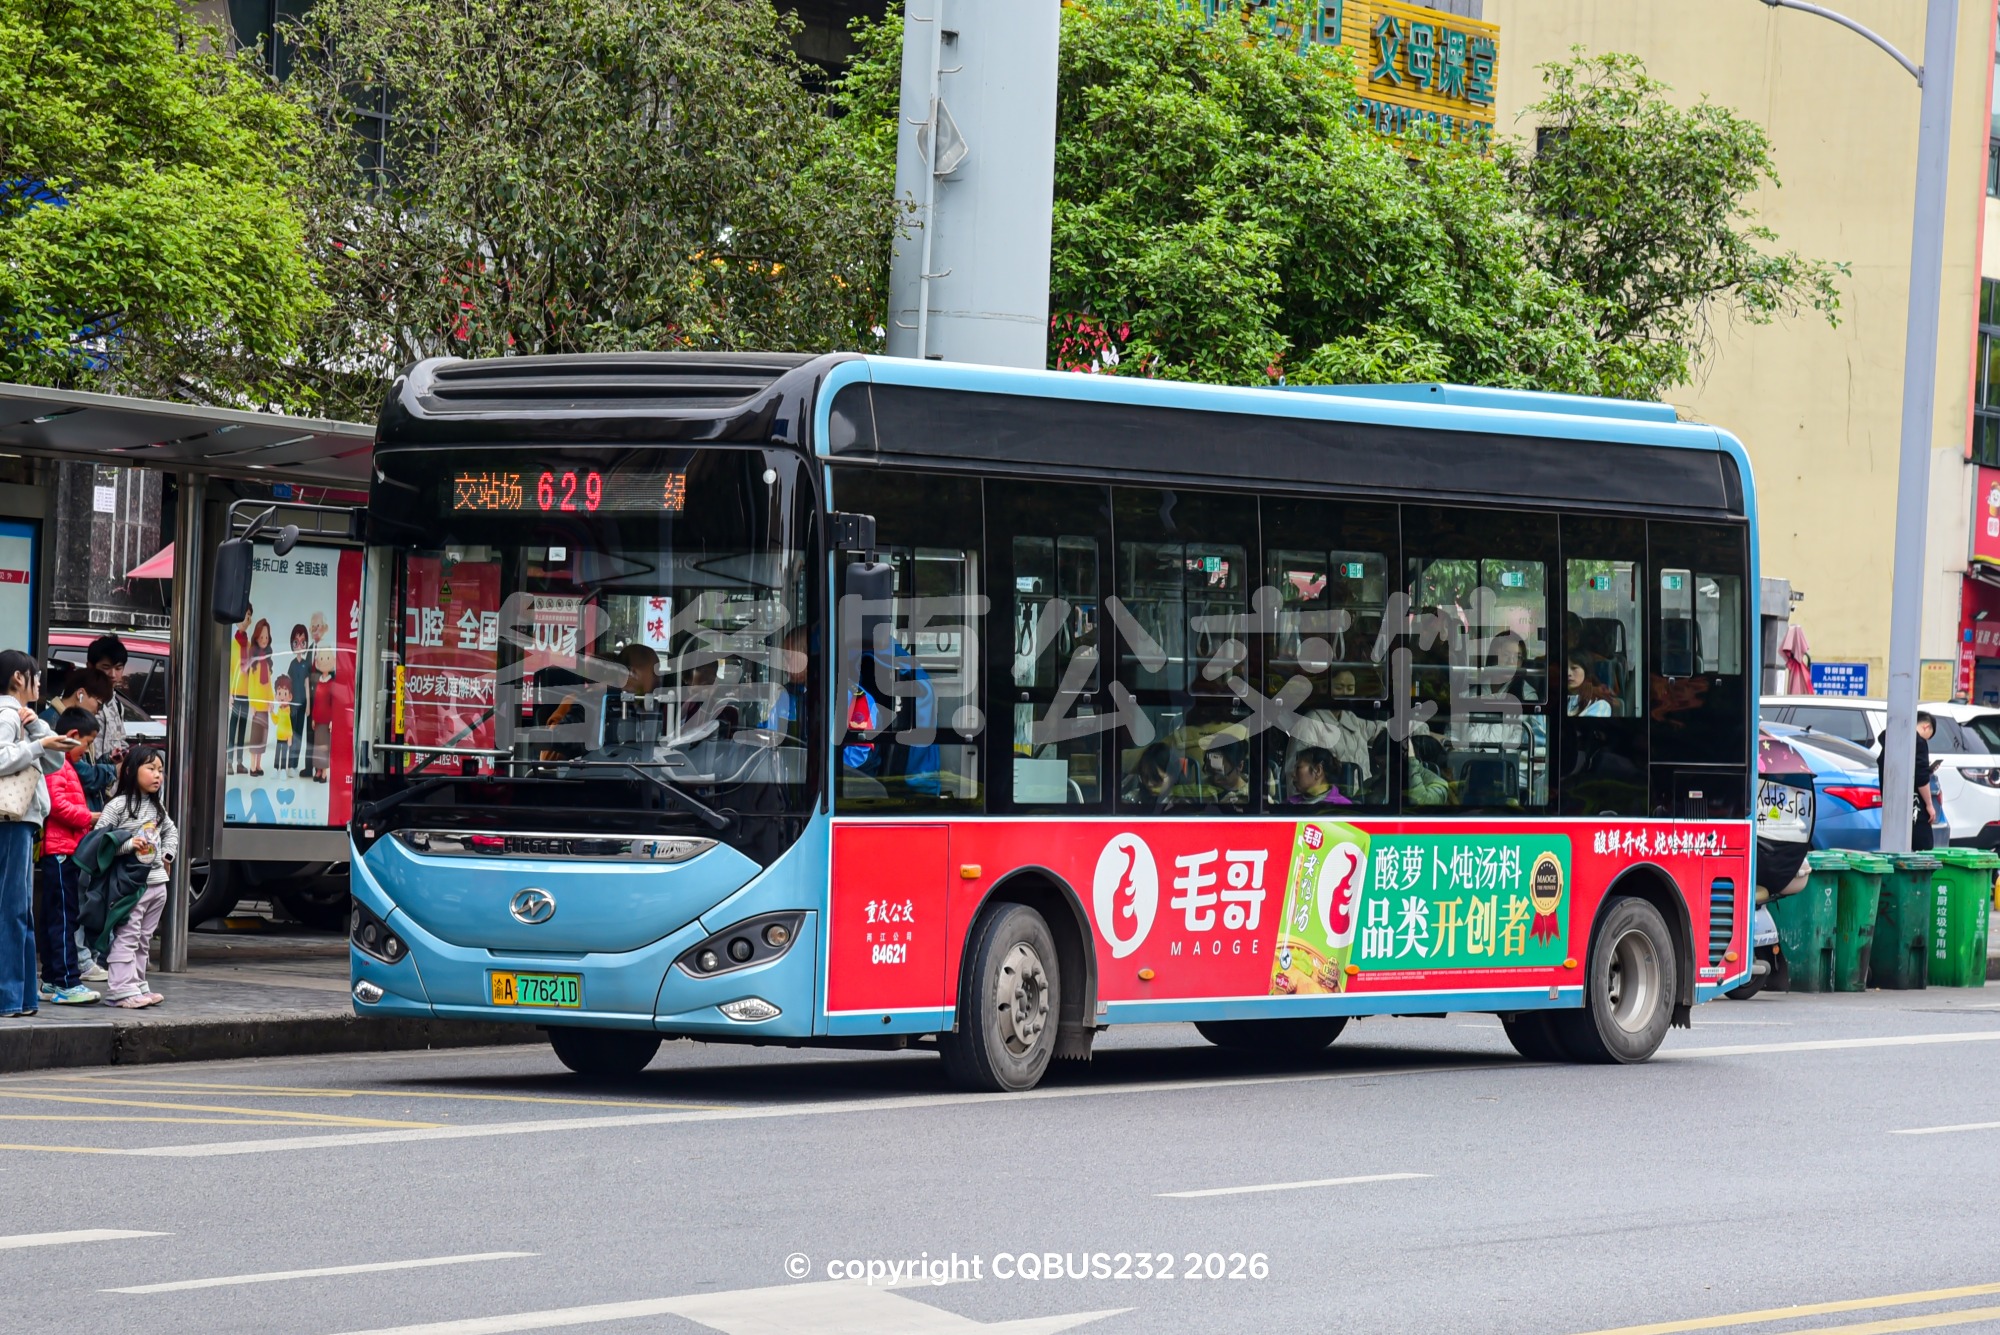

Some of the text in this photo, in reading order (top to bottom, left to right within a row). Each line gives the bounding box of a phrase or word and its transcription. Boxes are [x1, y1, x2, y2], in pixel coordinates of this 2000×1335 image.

[1374, 16, 1496, 104] 父母课堂
[454, 472, 523, 510] 交站场
[537, 472, 602, 511] 629
[295, 561, 328, 577] 全国连锁
[280, 808, 317, 819] WELLE
[1304, 826, 1323, 848] 毛哥
[1375, 845, 1522, 891] 酸萝卜炖汤料
[1170, 848, 1268, 932] 毛哥
[864, 899, 914, 924] 重庆公交
[1361, 894, 1530, 959] 品类开创者
[1936, 885, 1948, 960] 餐厨垃圾专用桶
[872, 943, 907, 964] 84621
[1170, 939, 1259, 956] MAOGE
